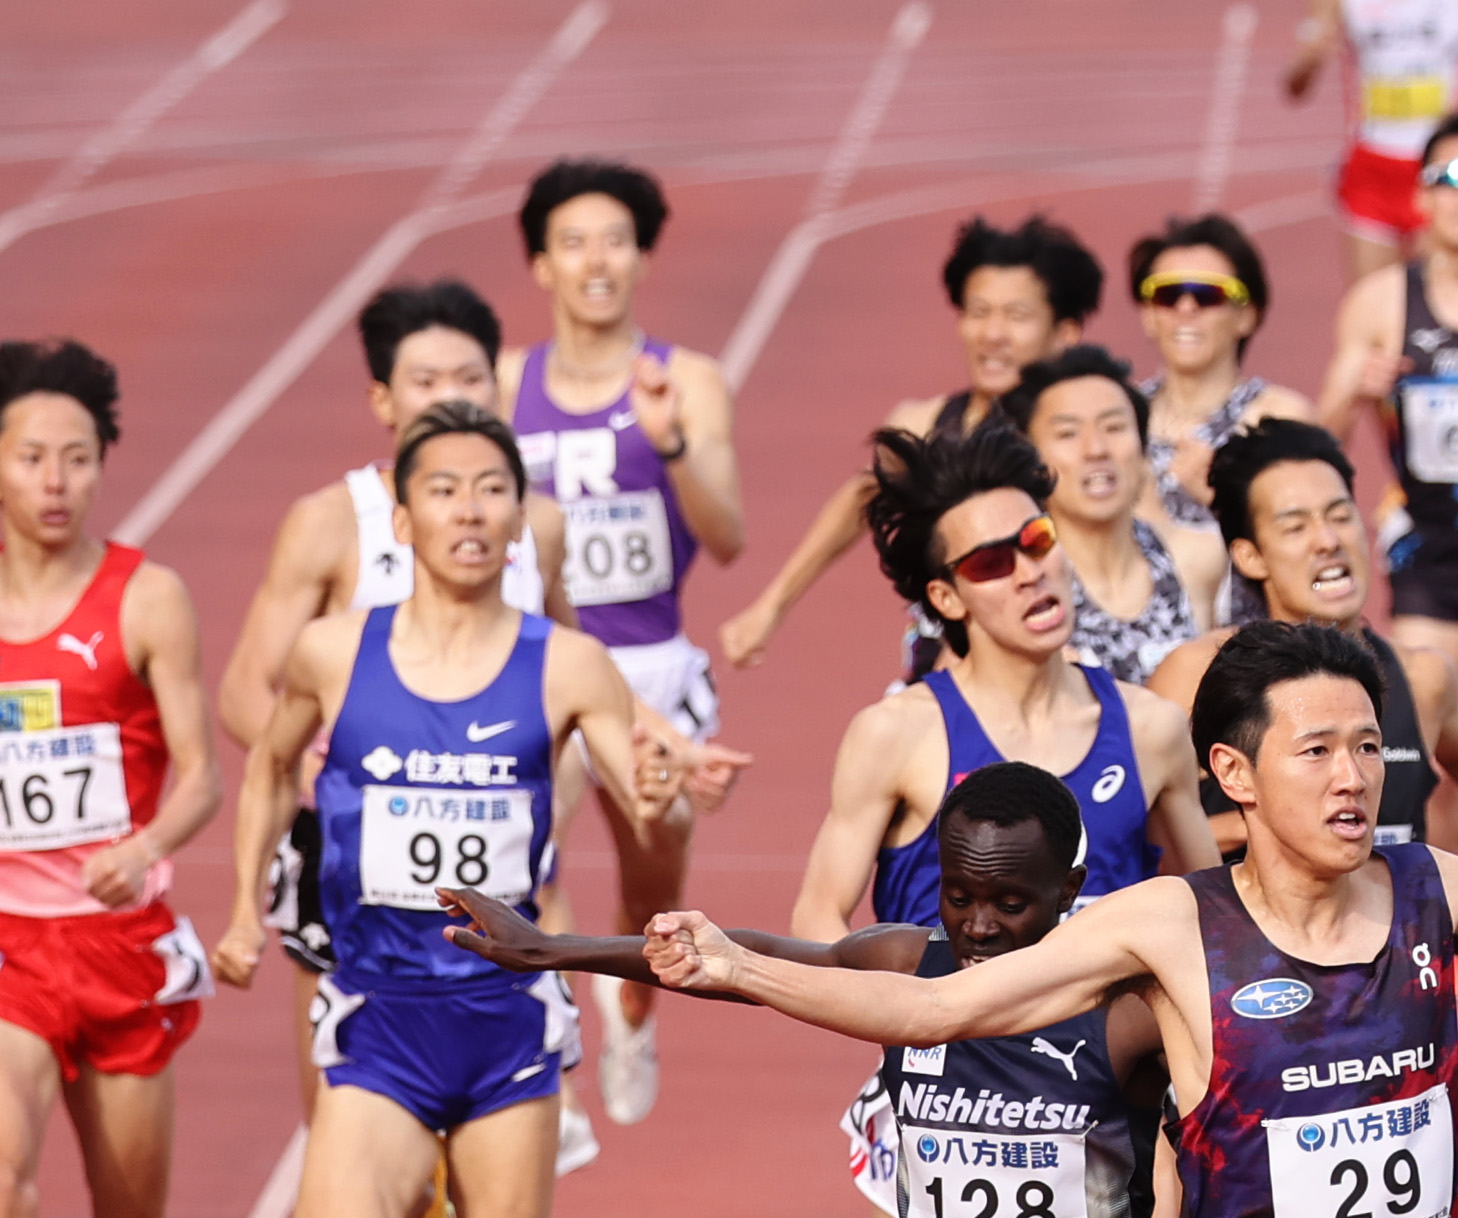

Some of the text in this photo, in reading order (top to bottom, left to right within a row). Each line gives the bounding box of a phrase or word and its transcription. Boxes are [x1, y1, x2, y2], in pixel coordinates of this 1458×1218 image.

[404, 749, 518, 787] 住友電工
[409, 832, 488, 886] 98
[1281, 1043, 1435, 1092] SUBARU
[898, 1080, 1090, 1130] Nishitetsu
[1330, 1097, 1432, 1149] 八方建設
[942, 1138, 1059, 1169] 八方建設
